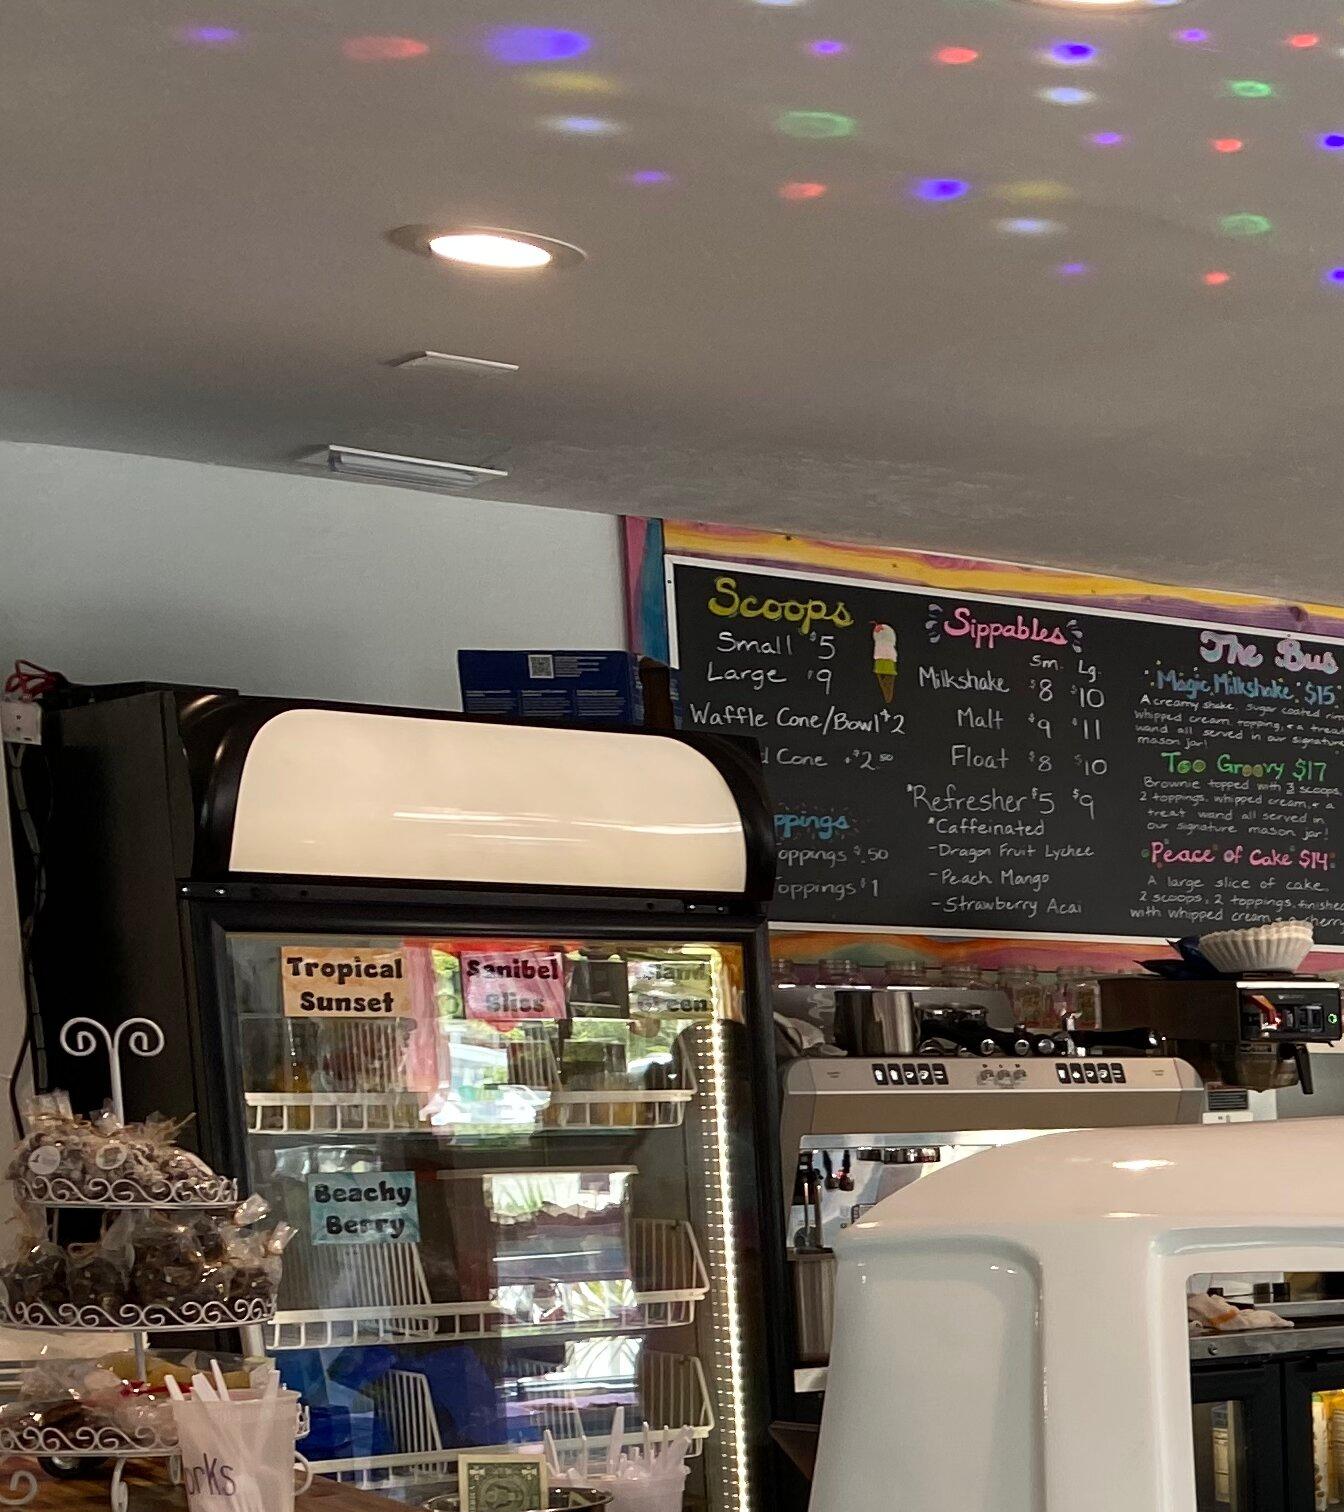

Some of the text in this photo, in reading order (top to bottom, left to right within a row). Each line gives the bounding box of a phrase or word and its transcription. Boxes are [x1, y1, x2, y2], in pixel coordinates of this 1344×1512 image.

[708, 576, 854, 634] Scoops
[944, 607, 1068, 648] Sippables
[717, 631, 792, 655] Small
[1200, 631, 1263, 668] The
[1275, 639, 1338, 674] Bus
[707, 661, 786, 690] Large
[919, 666, 1105, 707] Milkshake $8 $10
[1157, 670, 1335, 706] Magic Milkshake $15
[690, 702, 768, 726] Waffle
[777, 706, 880, 735] Cone/Bowl
[957, 707, 1004, 729] Malt
[1028, 712, 1052, 738] $9
[777, 749, 828, 766] Cone
[951, 744, 1107, 775] Float $8 $10
[1161, 751, 1327, 781] Too Groovy $17
[1143, 776, 1250, 795] Brownie topped
[1032, 787, 1054, 814] $5
[1072, 788, 1094, 819] $9
[1263, 812, 1307, 824] served
[776, 842, 848, 868] oppings
[1000, 842, 1095, 860] Fruit Lychee
[1151, 841, 1328, 871] Peace of Cake $14
[776, 877, 856, 900] oppings
[1001, 869, 1049, 891] Mango
[1168, 877, 1276, 893] large slice of
[1047, 898, 1081, 914] Acai
[1130, 906, 1223, 923] with whipped
[287, 957, 402, 985] Tropical
[466, 960, 559, 980] Sanibel
[300, 991, 394, 1014] Sunset
[315, 1181, 411, 1207] Beachy
[326, 1215, 405, 1239] Berry
